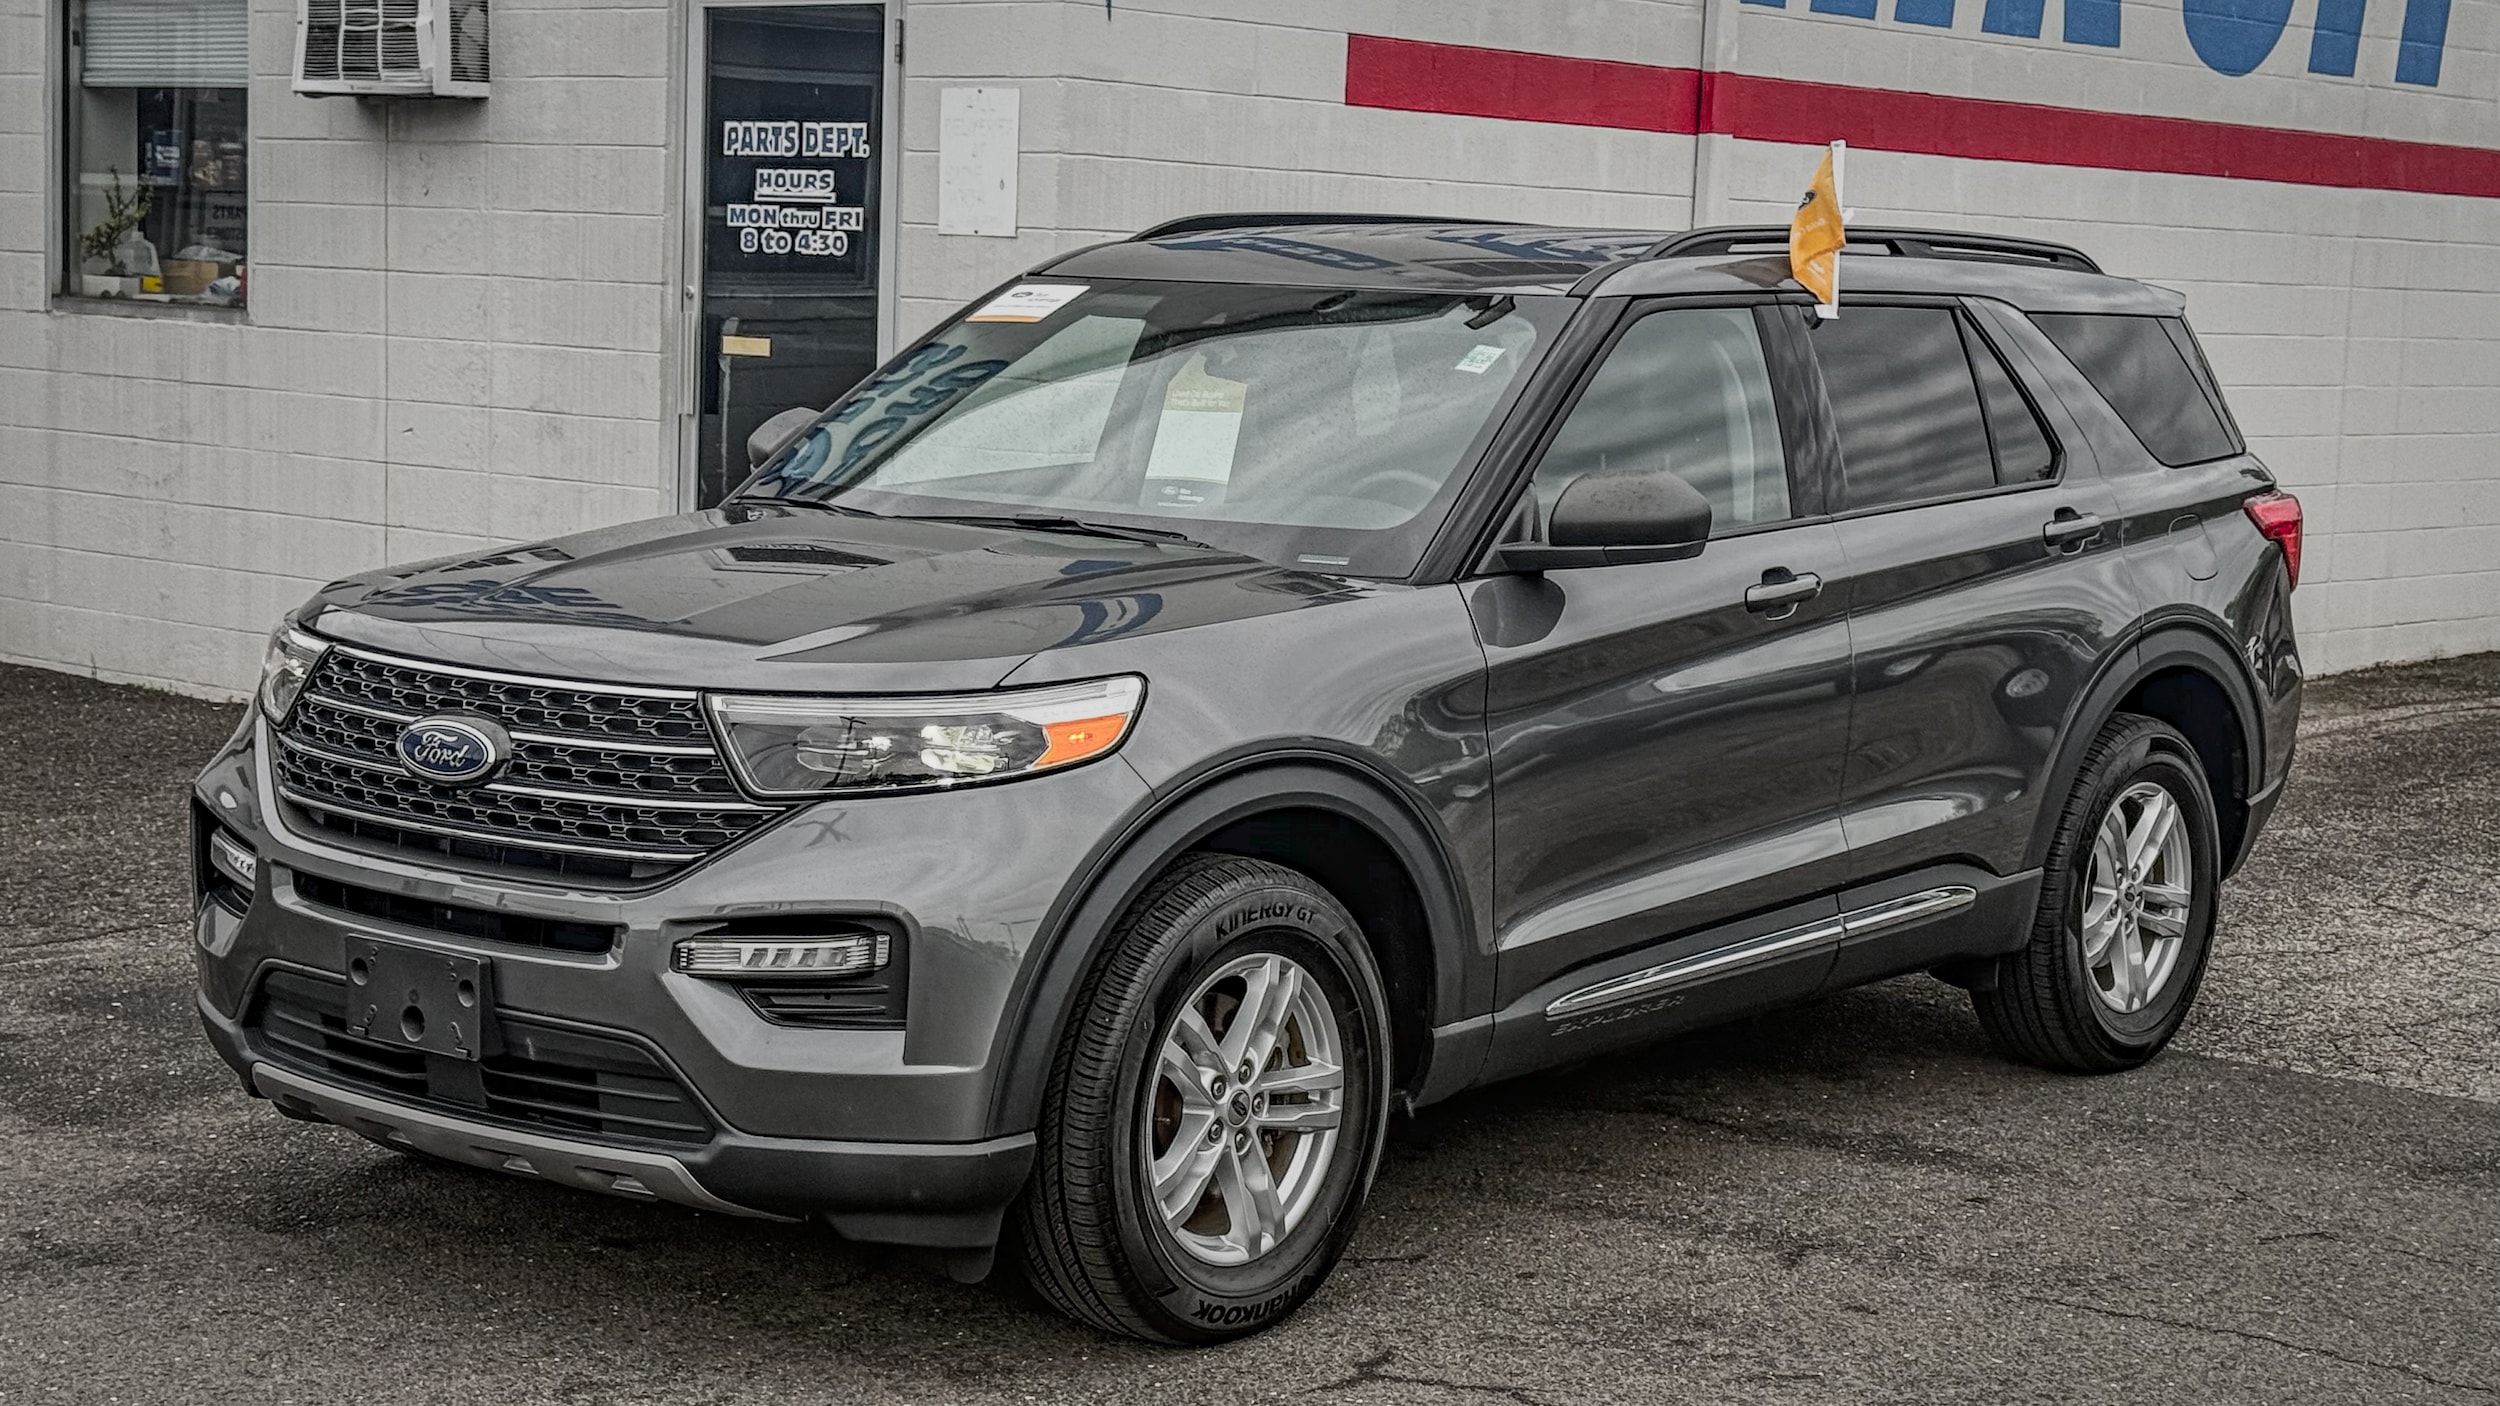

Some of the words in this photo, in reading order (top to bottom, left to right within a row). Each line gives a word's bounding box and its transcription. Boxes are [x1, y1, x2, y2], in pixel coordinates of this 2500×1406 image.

[723, 121, 799, 157] PARTS
[802, 122, 870, 158] DEPT.
[756, 169, 835, 192] HOURS
[727, 204, 780, 228] MON
[780, 208, 821, 228] thru
[822, 207, 864, 231] FRI
[740, 228, 759, 253] 8
[761, 229, 792, 254] to
[795, 230, 848, 256] 4:30
[414, 731, 470, 768] Ford
[1297, 906, 1317, 925] GT
[1551, 996, 1686, 1036] EXPLORER
